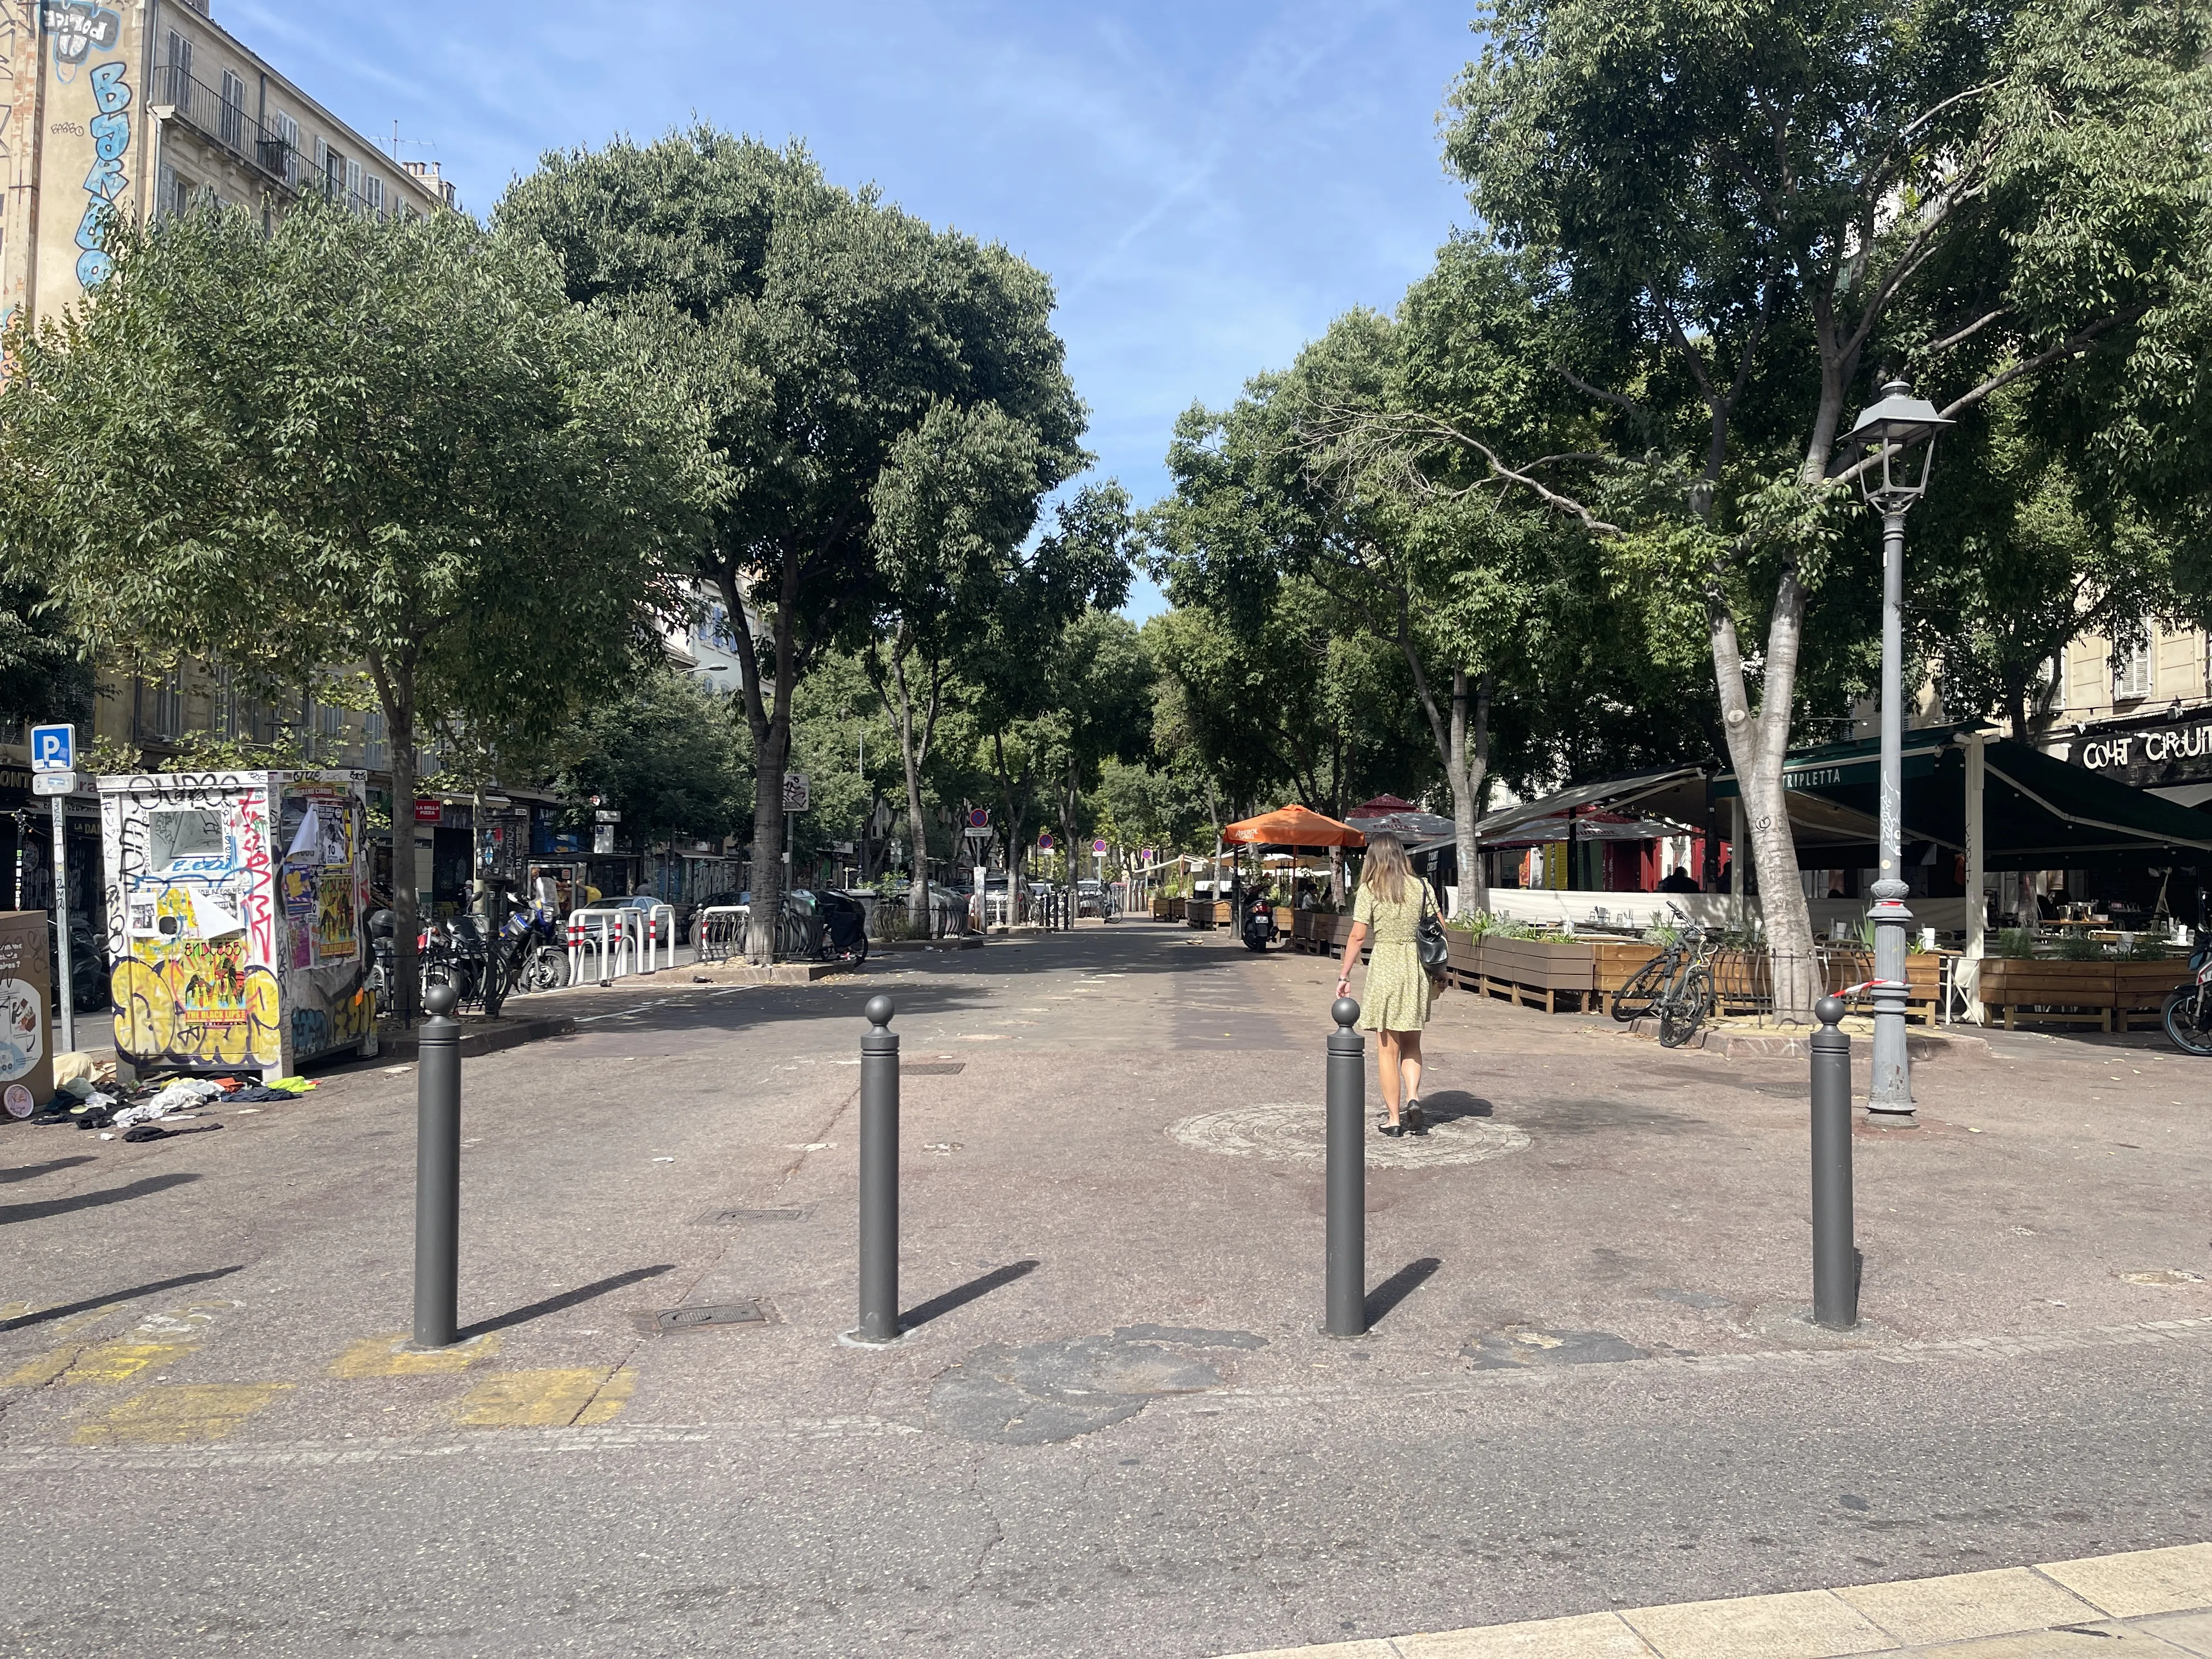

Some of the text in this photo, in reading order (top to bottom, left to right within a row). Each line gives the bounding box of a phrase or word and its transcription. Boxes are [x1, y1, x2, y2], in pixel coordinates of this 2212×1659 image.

[43, 735, 60, 762] P
[2083, 737, 2132, 769] COURT
[1235, 828, 1258, 839] APEROL
[328, 844, 336, 855] 10
[201, 1011, 224, 1019] BLACK
[225, 1010, 240, 1018] LIPS
